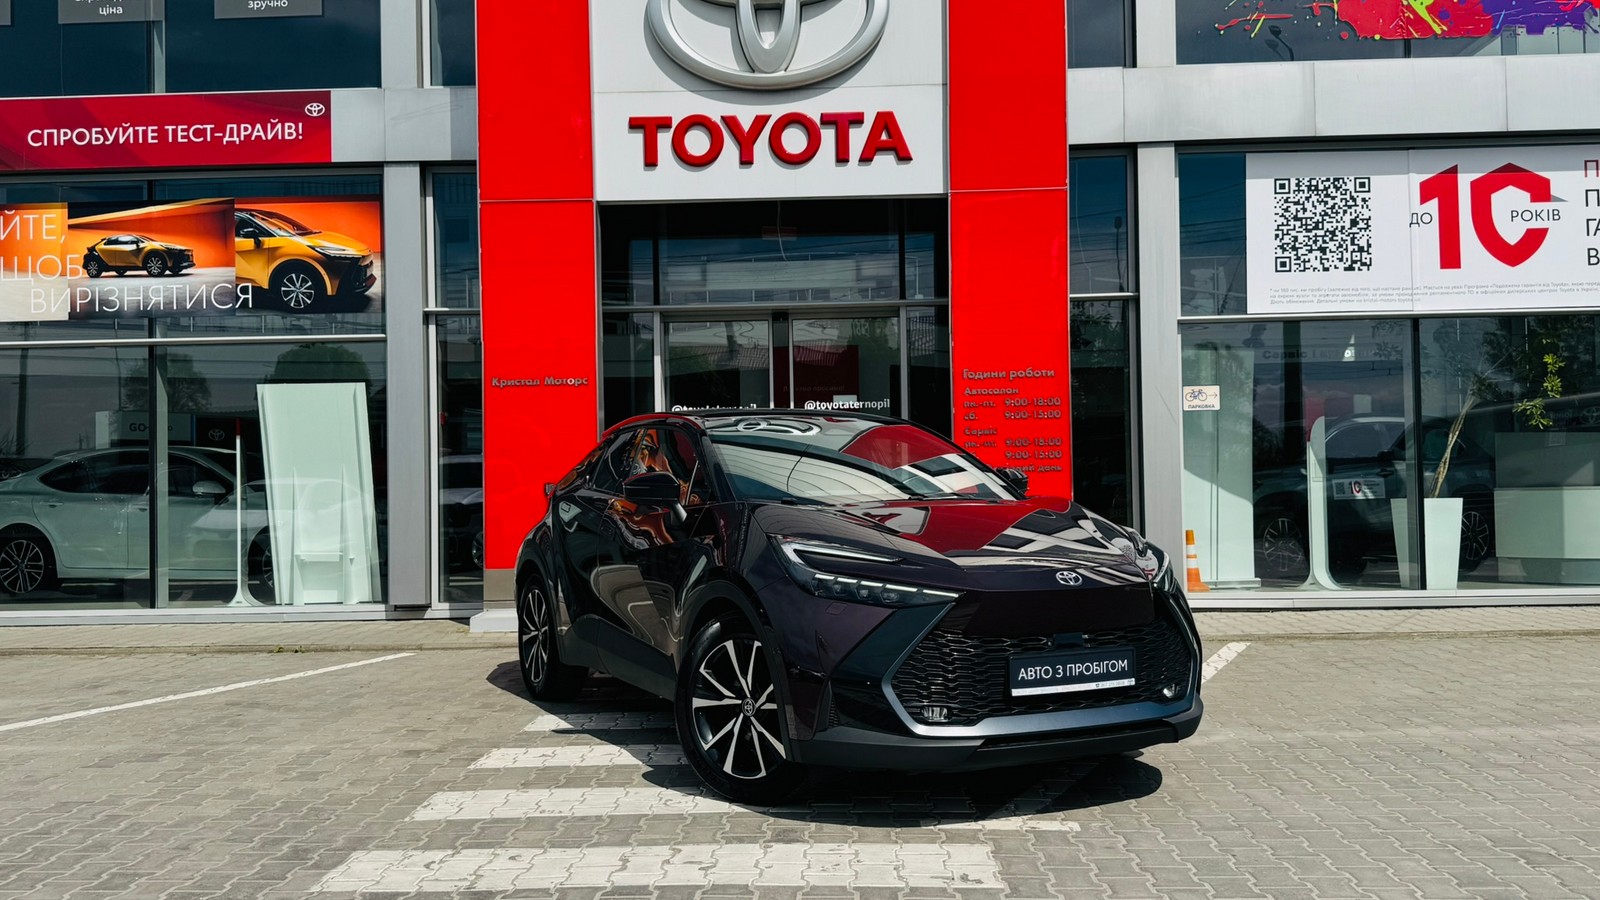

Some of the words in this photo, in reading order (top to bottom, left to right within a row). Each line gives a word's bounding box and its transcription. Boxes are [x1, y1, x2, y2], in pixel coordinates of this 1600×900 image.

[99, 4, 123, 16] ціна
[27, 123, 159, 147] СПРОБУЙТЕ
[164, 119, 304, 144] ТЕСТ-ДРАЙВ!
[628, 110, 912, 167] TOYOTA
[1409, 212, 1433, 227] ДО
[1510, 208, 1561, 222] РОКІВ
[0, 254, 83, 285] ЩОБ
[31, 283, 253, 314] ВИРІЗНЯТИСЯ
[492, 377, 540, 388] Кристал
[544, 375, 588, 387] Моторс
[963, 369, 1006, 380] Години
[1008, 367, 1055, 381] роботи
[964, 387, 1019, 396] Автосалон
[804, 398, 890, 411] @toyotaternopil
[1018, 666, 1053, 681] АВТО
[1055, 665, 1064, 678] З
[1066, 660, 1128, 676] ПРОБІГОМ
